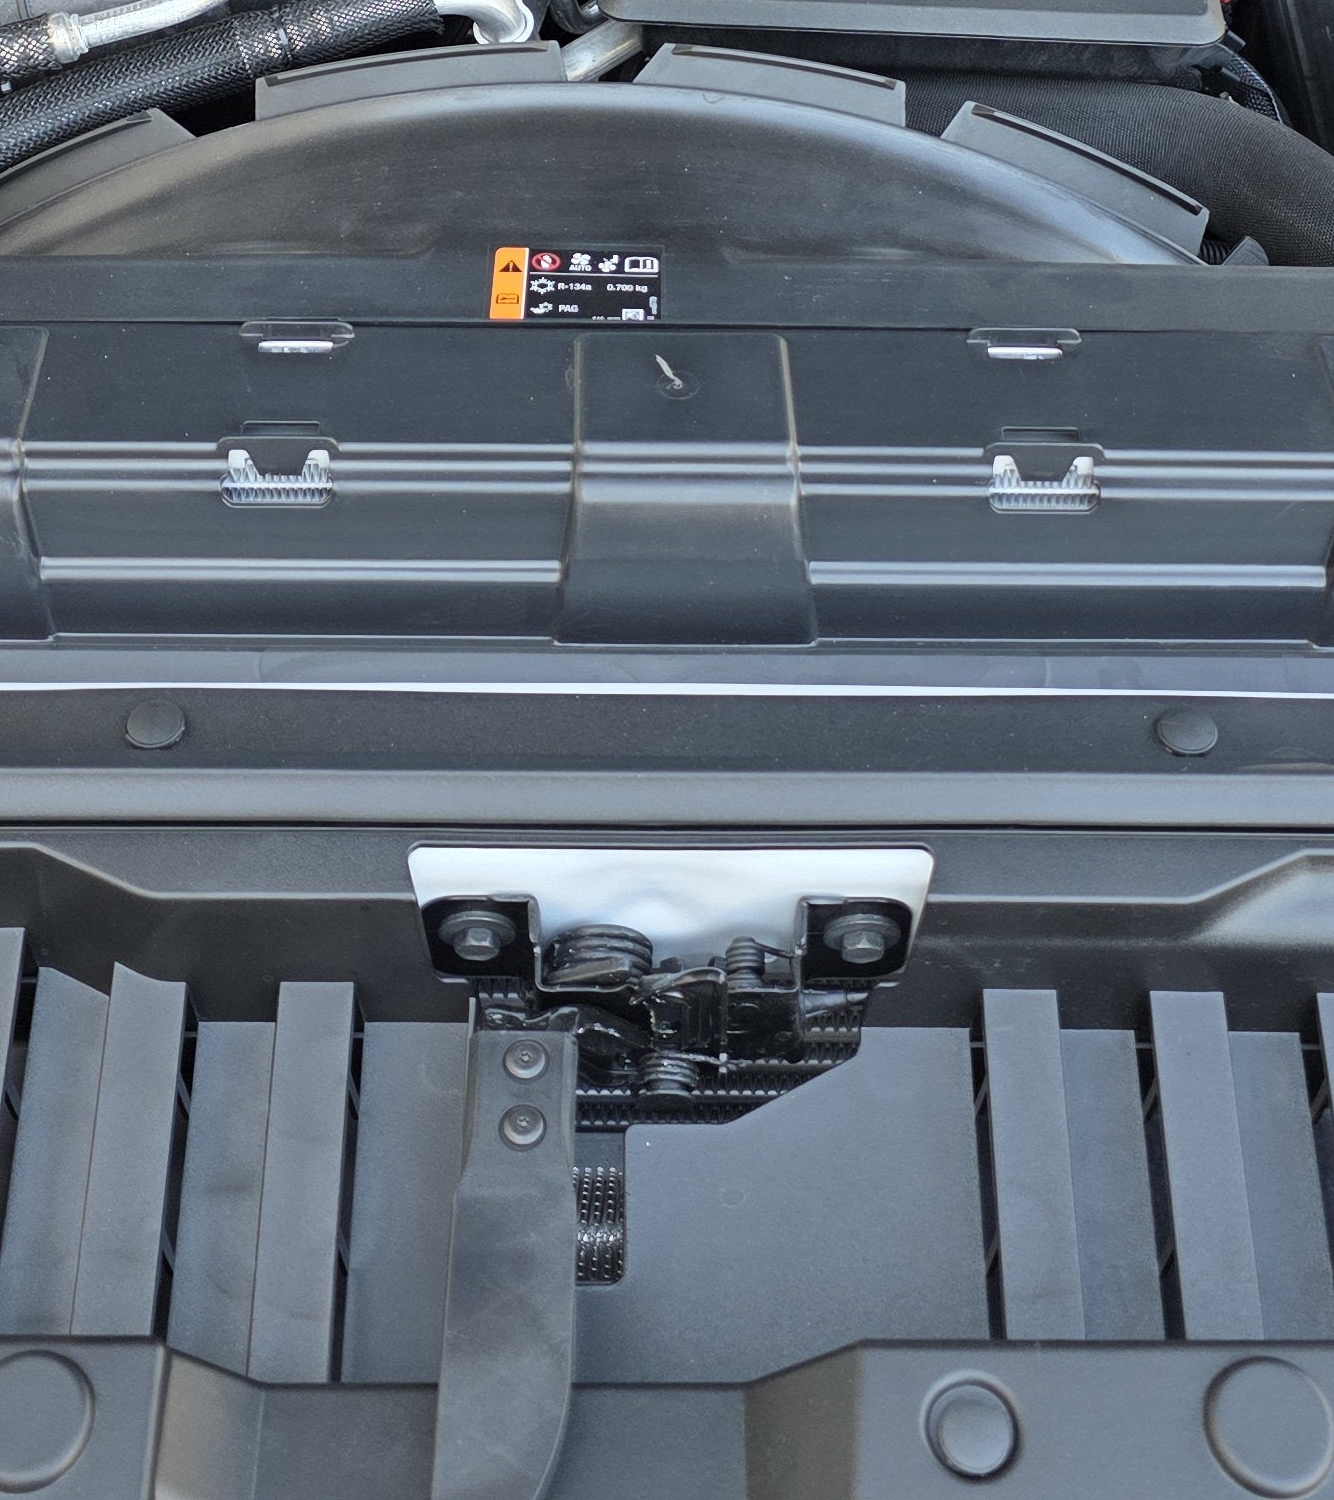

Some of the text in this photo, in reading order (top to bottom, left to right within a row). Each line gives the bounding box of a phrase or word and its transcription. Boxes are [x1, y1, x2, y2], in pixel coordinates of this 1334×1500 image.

[569, 264, 593, 272] AUTO
[558, 283, 648, 293] R-134a 0.700 kg
[558, 305, 579, 313] PAG
